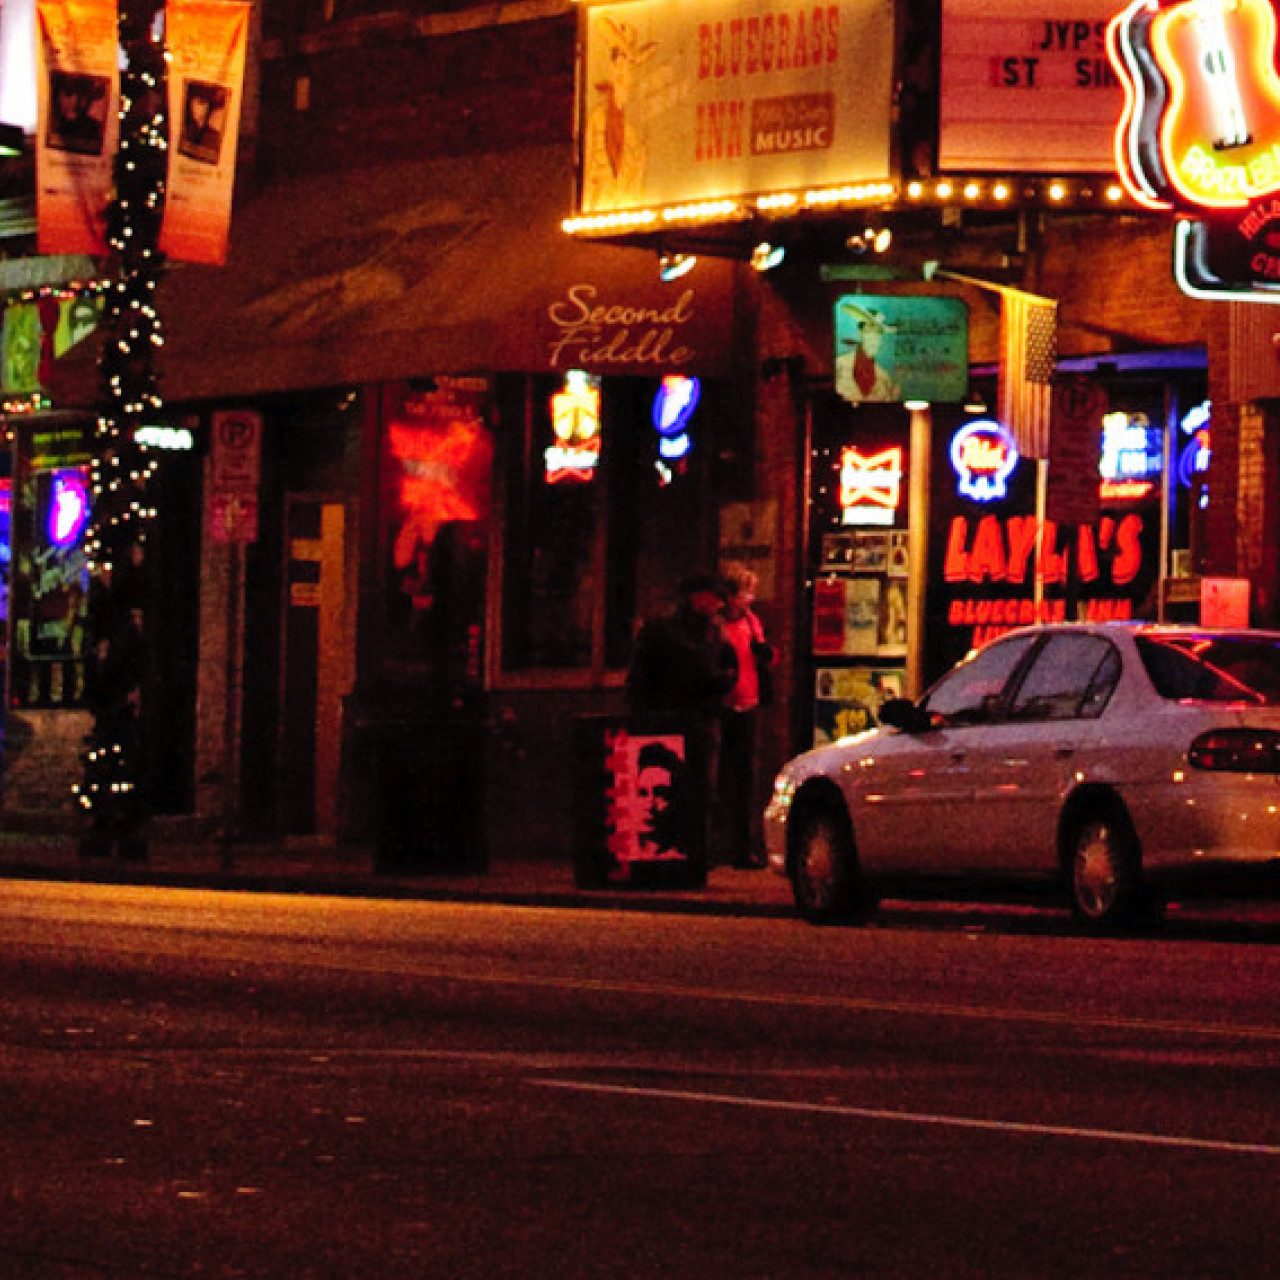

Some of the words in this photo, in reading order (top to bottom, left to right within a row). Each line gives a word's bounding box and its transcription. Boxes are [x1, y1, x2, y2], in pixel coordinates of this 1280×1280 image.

[698, 4, 839, 80] BLUEGRASS
[756, 126, 828, 152] MUSIC
[548, 284, 695, 326] Second
[548, 326, 696, 366] Fiddle
[944, 513, 1144, 585] LAYL'S
